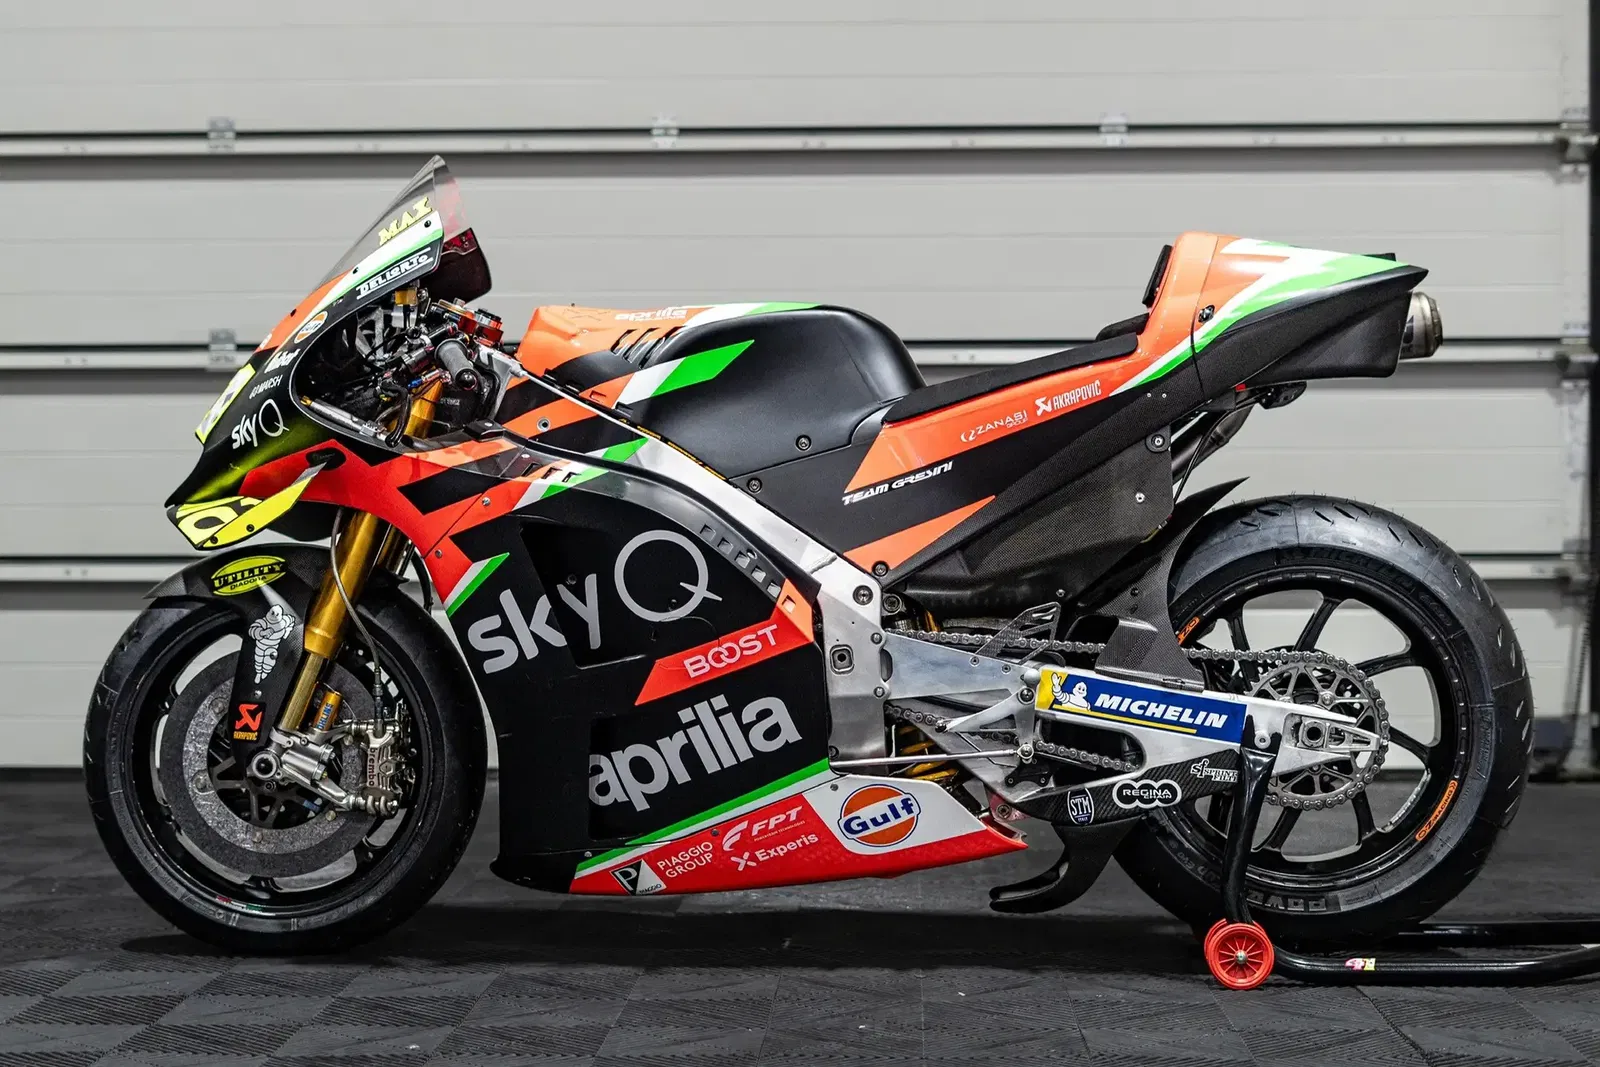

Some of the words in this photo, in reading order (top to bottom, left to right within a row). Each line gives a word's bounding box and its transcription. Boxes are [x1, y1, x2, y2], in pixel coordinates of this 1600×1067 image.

[378, 195, 433, 246] MAX
[258, 398, 290, 437] Q
[976, 409, 1027, 435] ZANASI
[842, 483, 889, 506] TEAM
[891, 460, 953, 489] GRESINI
[213, 563, 284, 588] UTILITY
[467, 573, 601, 674] sky
[614, 529, 722, 622] Q
[683, 624, 778, 679] BOOST
[1094, 692, 1228, 729] MICHELIN
[368, 747, 378, 786] brembo
[588, 694, 802, 812] aprilia
[752, 805, 803, 837] FPT
[843, 796, 915, 835] Gulf
[1070, 796, 1092, 816] STM
[656, 841, 713, 870] PIAGGIO
[665, 852, 713, 878] GROUP
[754, 833, 819, 862] Experis
